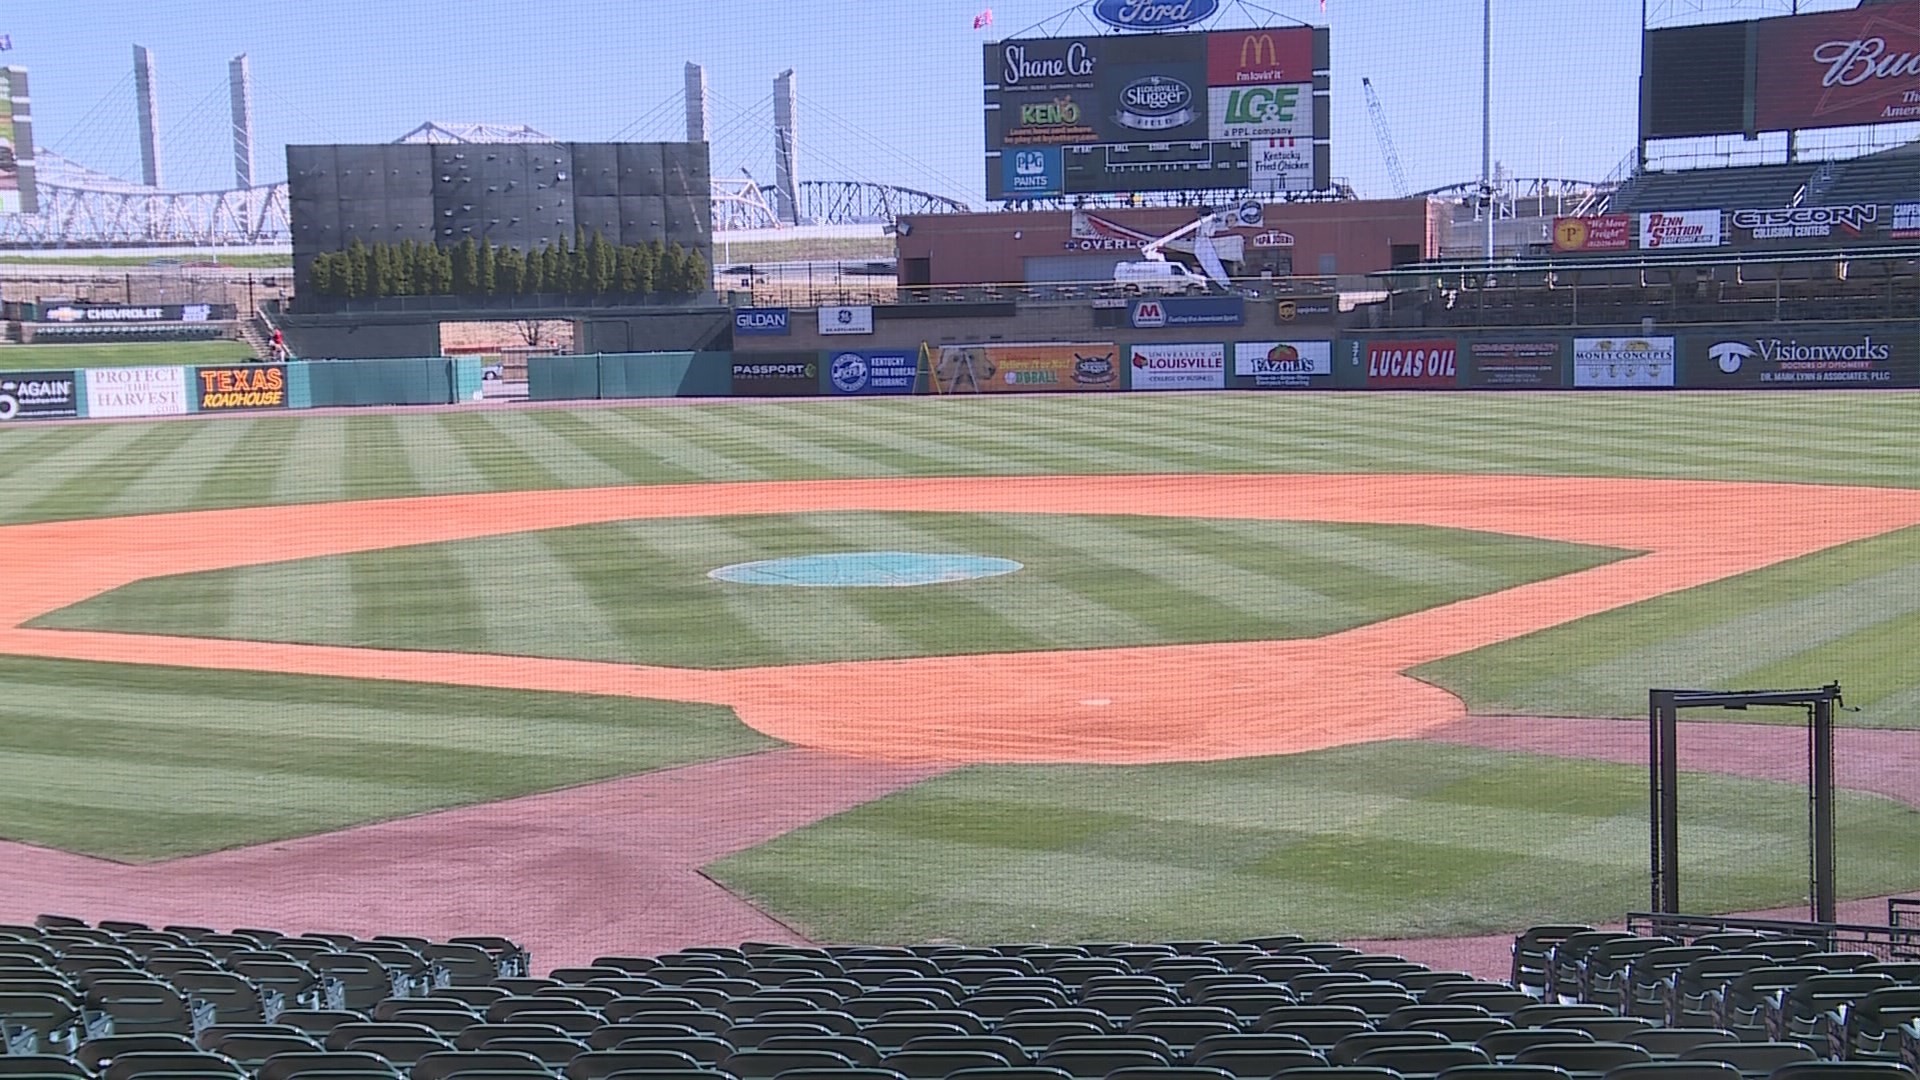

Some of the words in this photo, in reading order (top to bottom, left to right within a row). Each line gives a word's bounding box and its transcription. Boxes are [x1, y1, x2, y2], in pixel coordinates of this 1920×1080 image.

[1118, 0, 1192, 22] Ford
[1004, 45, 1066, 84] Shane
[1140, 84, 1180, 93] LOUISVILLE
[1127, 87, 1186, 108] Slugger
[1224, 87, 1299, 124] LG&E
[1021, 103, 1081, 125] KENO
[1232, 128, 1250, 136] PPL
[1017, 152, 1043, 171] PPG
[1263, 151, 1301, 161] Kentucky
[1255, 160, 1277, 171] Fried
[1277, 160, 1309, 171] Chicken
[1014, 176, 1048, 186] PAINTS
[1605, 219, 1627, 227] Move
[1733, 204, 1877, 230] ETSCORN
[1647, 214, 1684, 233] PENN
[1649, 225, 1703, 247] STATION
[1753, 226, 1793, 238] COLLISION
[1794, 225, 1830, 236] CENTERS
[1080, 239, 1150, 250] OVERLO
[87, 308, 163, 319] CHEVROLET
[737, 314, 785, 326] GILDAN
[1756, 336, 1889, 361] Visionworks
[1616, 351, 1672, 359] CONCEPTS
[871, 357, 905, 366] KENTUCKY
[1149, 358, 1223, 369] LOUISVILLE
[1250, 358, 1315, 373] FAZOLI'S
[1369, 350, 1425, 377] LUCAS
[1428, 350, 1456, 377] OIL
[733, 364, 805, 374] PASSPORT
[871, 367, 889, 376] FARM
[890, 366, 916, 376] BUREAU
[95, 369, 178, 384] PROTECT
[201, 368, 283, 392] TEXAS
[871, 377, 908, 387] INSURANCE
[1774, 373, 1796, 381] MARK
[1796, 373, 1815, 381] LYNN
[1871, 372, 1890, 380] PLLC
[17, 381, 68, 396] AGAIN
[126, 382, 150, 391] THE
[98, 391, 179, 407] HARVEST
[203, 391, 283, 407] ROADHOUSE
[152, 405, 180, 414] .com
